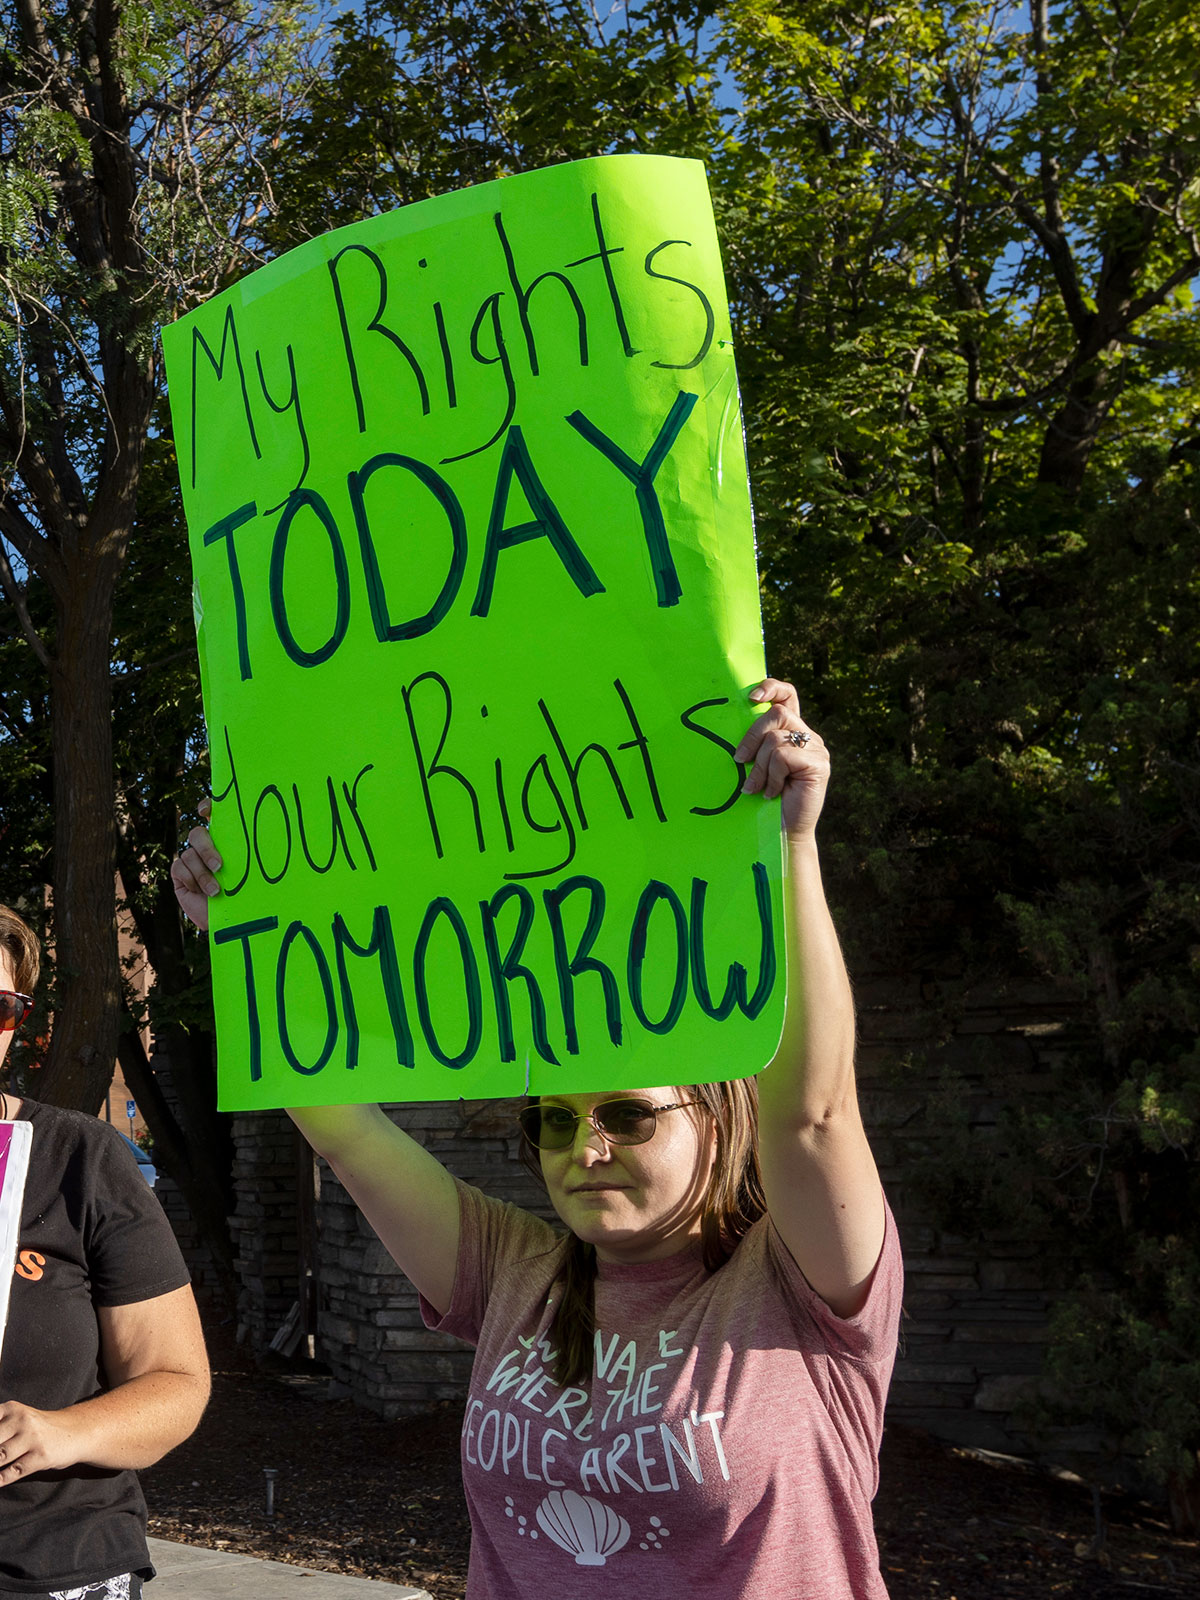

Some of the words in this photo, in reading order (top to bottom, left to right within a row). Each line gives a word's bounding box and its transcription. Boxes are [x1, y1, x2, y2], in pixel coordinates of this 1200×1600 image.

[191, 304, 310, 517] My
[327, 192, 715, 465] Rights
[202, 390, 700, 682] TODAY
[401, 670, 748, 881] Rights
[214, 861, 777, 1082] TOMORROW
[579, 1409, 731, 1494] AREN'T
[600, 1362, 668, 1432] THE
